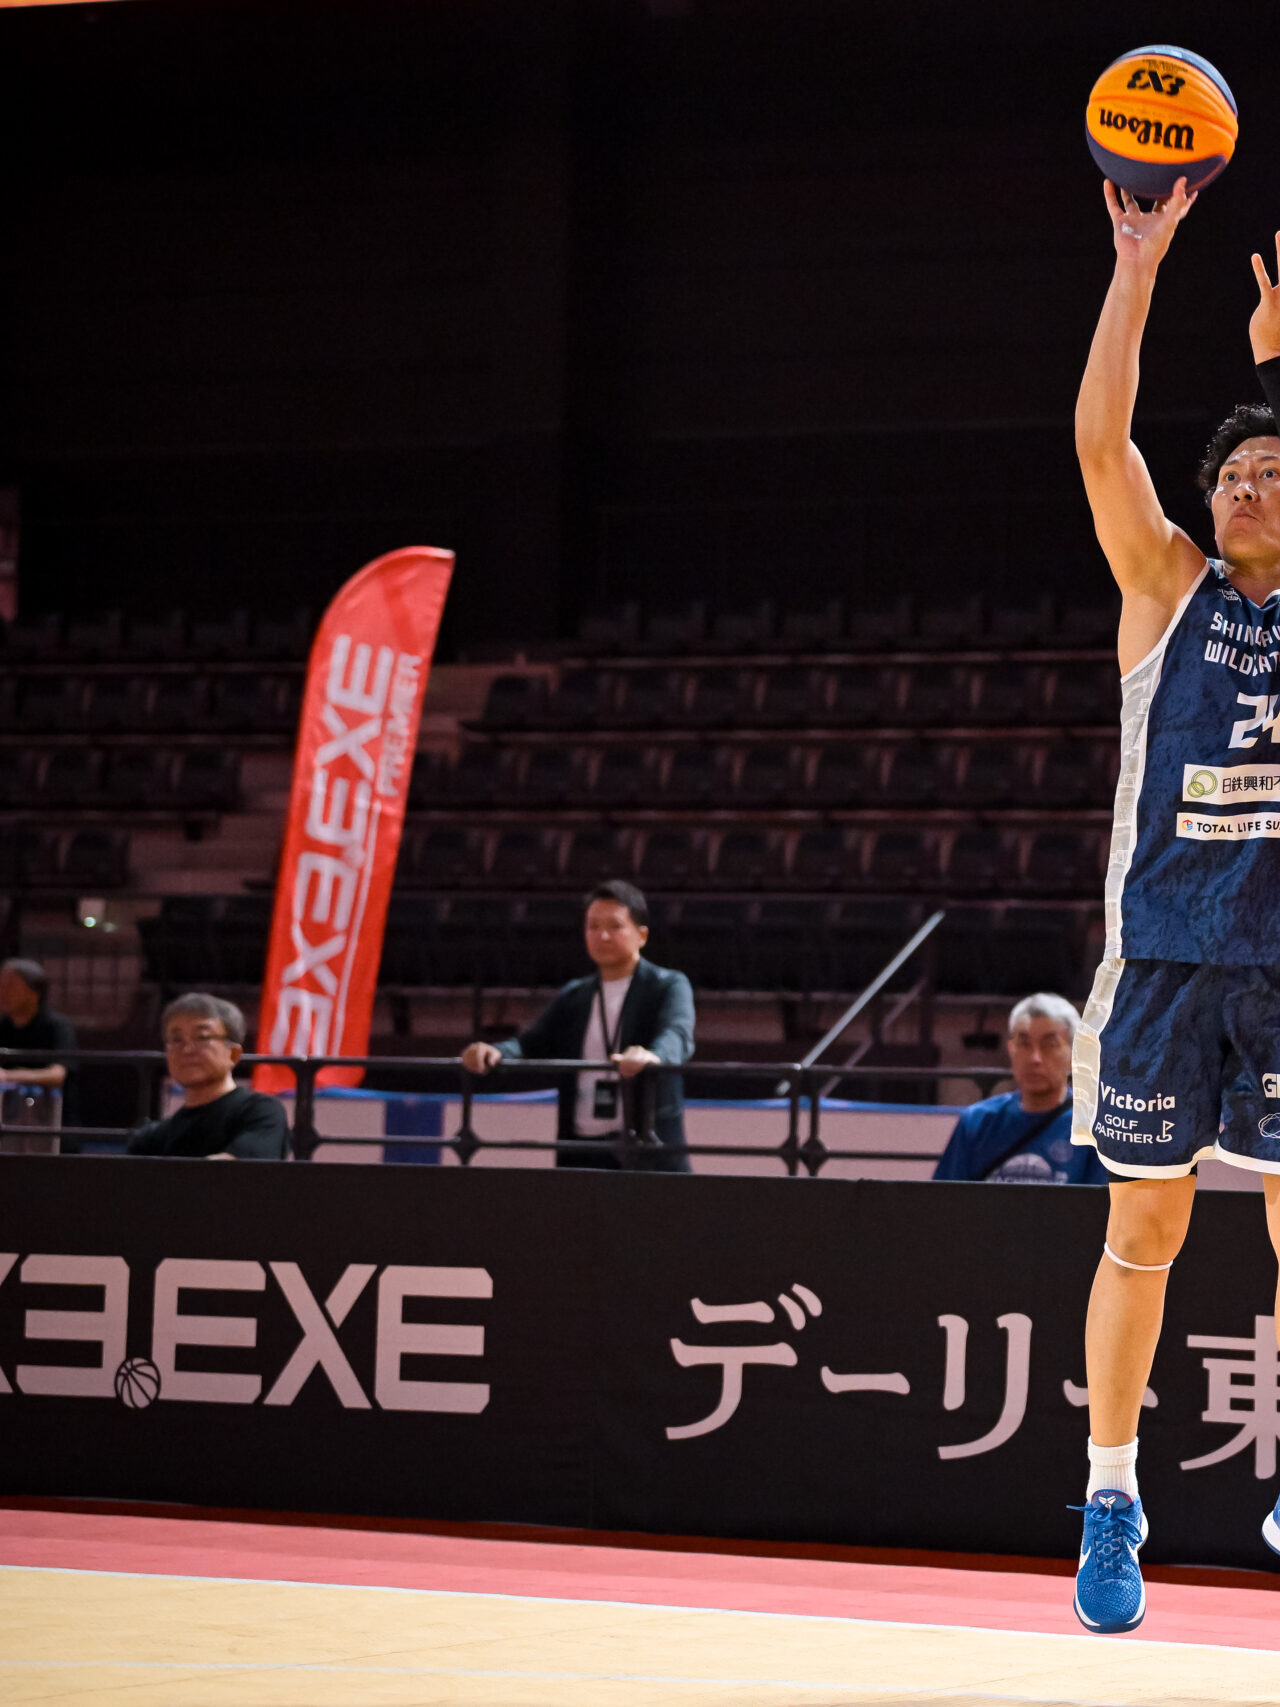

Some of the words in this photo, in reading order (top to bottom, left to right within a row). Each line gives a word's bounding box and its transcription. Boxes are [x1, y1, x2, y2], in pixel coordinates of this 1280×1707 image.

[1099, 108, 1195, 151] Wilson
[377, 653, 422, 796] PREMIER
[1197, 822, 1233, 833] TOTAL
[1237, 821, 1261, 832] LIFE
[1100, 1081, 1176, 1112] Victoria
[1094, 1121, 1153, 1144] PARTNER
[1104, 1113, 1138, 1130] GOLF
